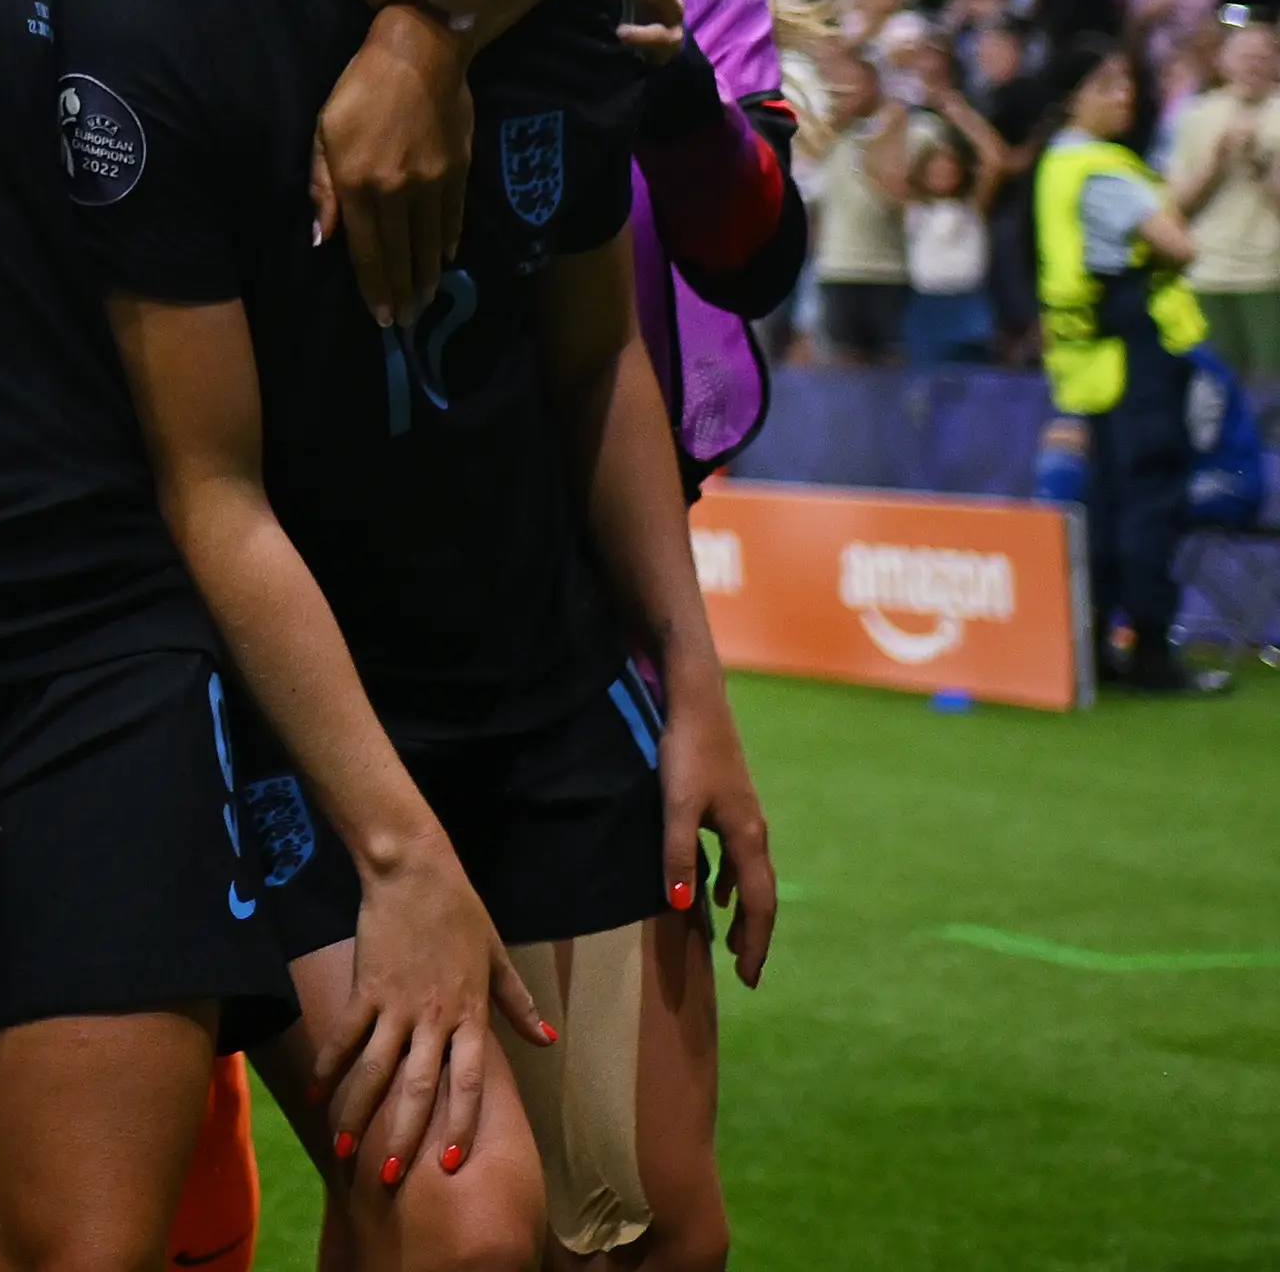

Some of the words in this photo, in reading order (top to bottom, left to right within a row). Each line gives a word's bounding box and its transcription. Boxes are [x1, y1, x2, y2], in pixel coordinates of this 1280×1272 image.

[72, 139, 136, 165] CHAMPIONS
[75, 128, 133, 152] EUROPEAN
[82, 157, 119, 178] 2022
[841, 539, 1016, 622] amazon
